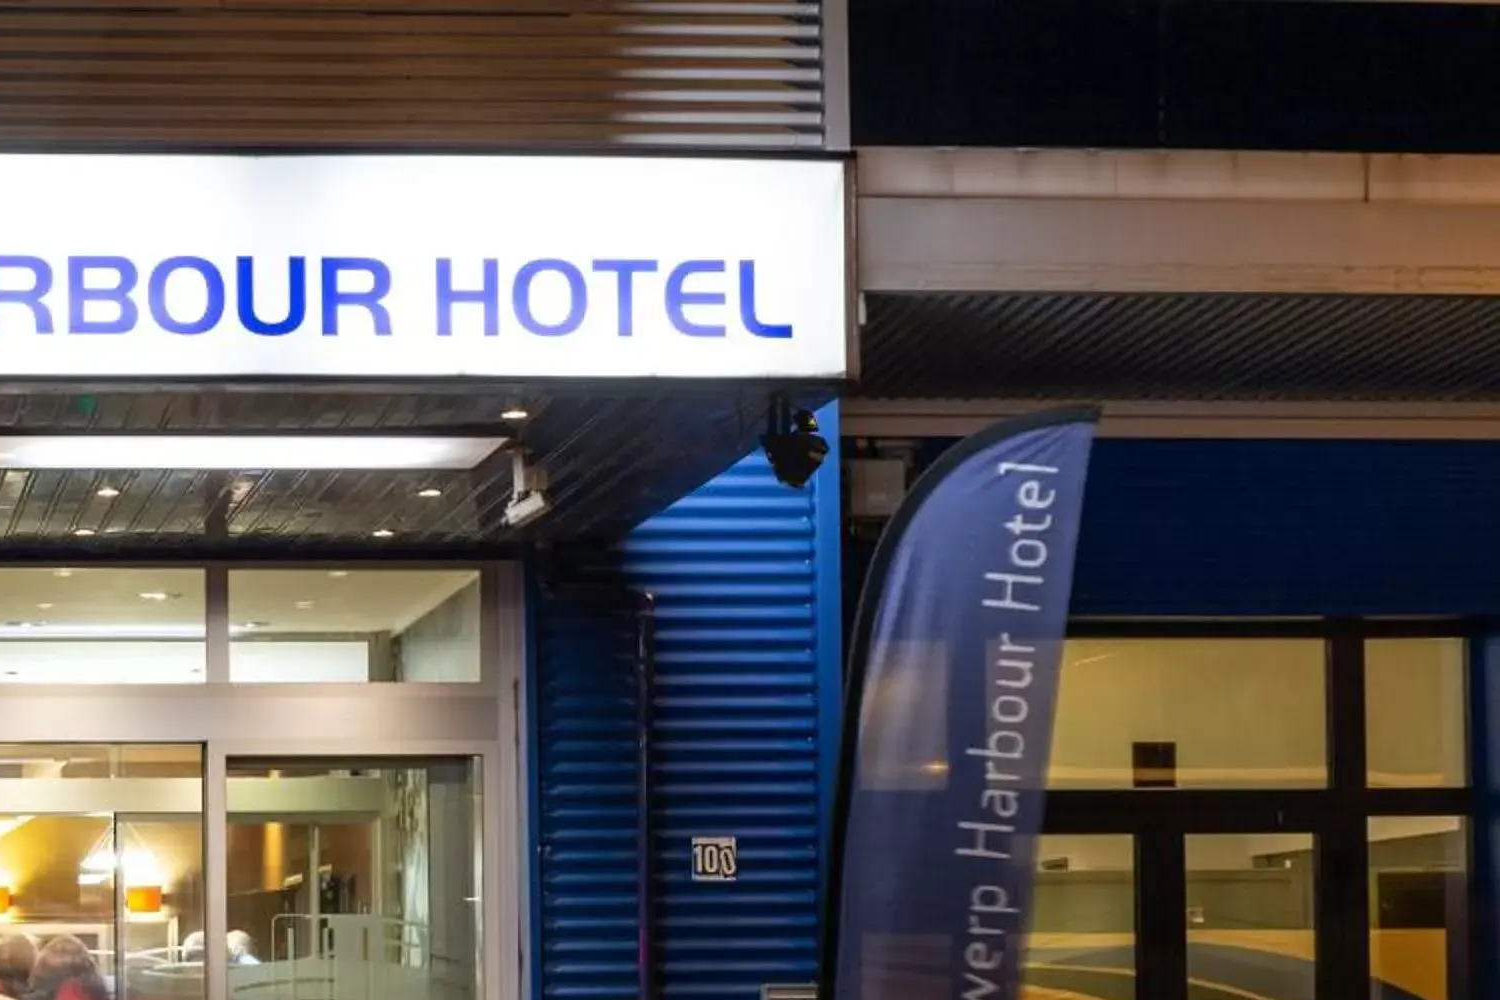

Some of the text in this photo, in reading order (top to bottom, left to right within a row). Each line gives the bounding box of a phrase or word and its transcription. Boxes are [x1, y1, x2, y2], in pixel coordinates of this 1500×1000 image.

[436, 258, 793, 339] HOTEL
[981, 461, 1059, 611] Hotel
[954, 631, 1036, 859] Harbour
[694, 845, 736, 875] 100
